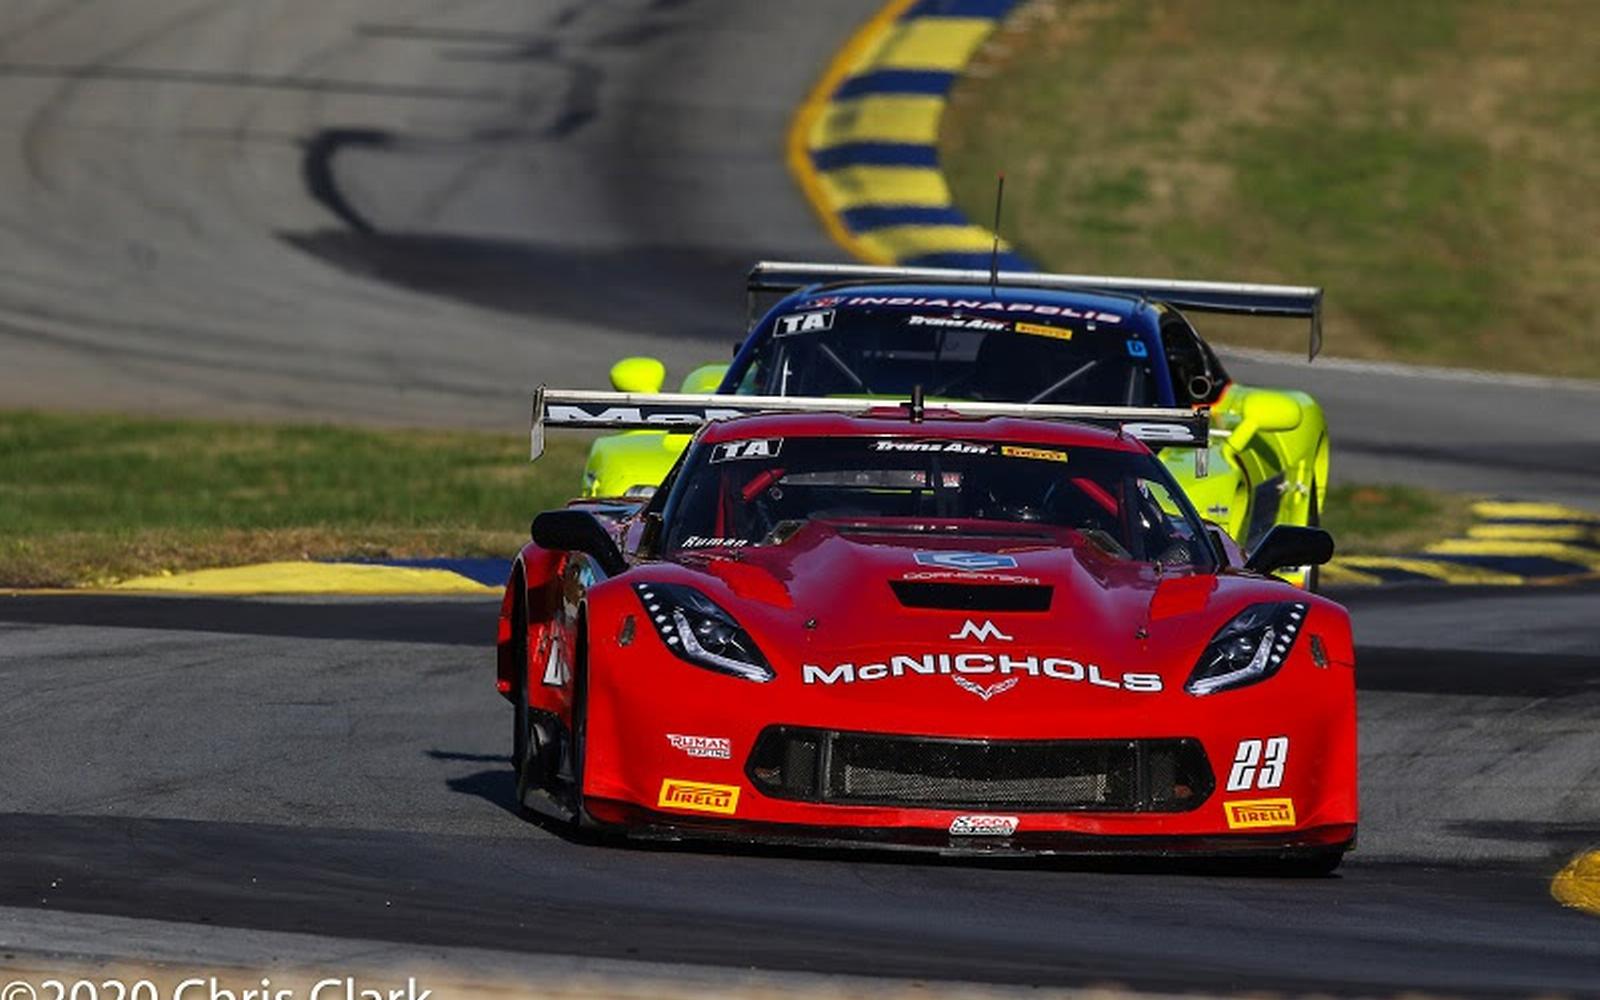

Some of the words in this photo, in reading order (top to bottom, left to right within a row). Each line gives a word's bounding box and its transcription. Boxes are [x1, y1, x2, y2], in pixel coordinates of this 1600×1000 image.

[847, 296, 1122, 324] INDIANAPOLIS
[783, 312, 826, 334] TA
[908, 315, 966, 328] Trans
[966, 318, 1005, 332] Am
[722, 439, 769, 459] TA
[874, 440, 943, 451] Trans
[943, 443, 989, 454] Am
[681, 536, 748, 548] Ruman
[803, 653, 1164, 692] McNICHOLS
[667, 734, 731, 749] RUMAN
[1226, 737, 1289, 792] 23
[665, 784, 733, 807] PIRELLI
[1231, 804, 1291, 823] PIRELLI
